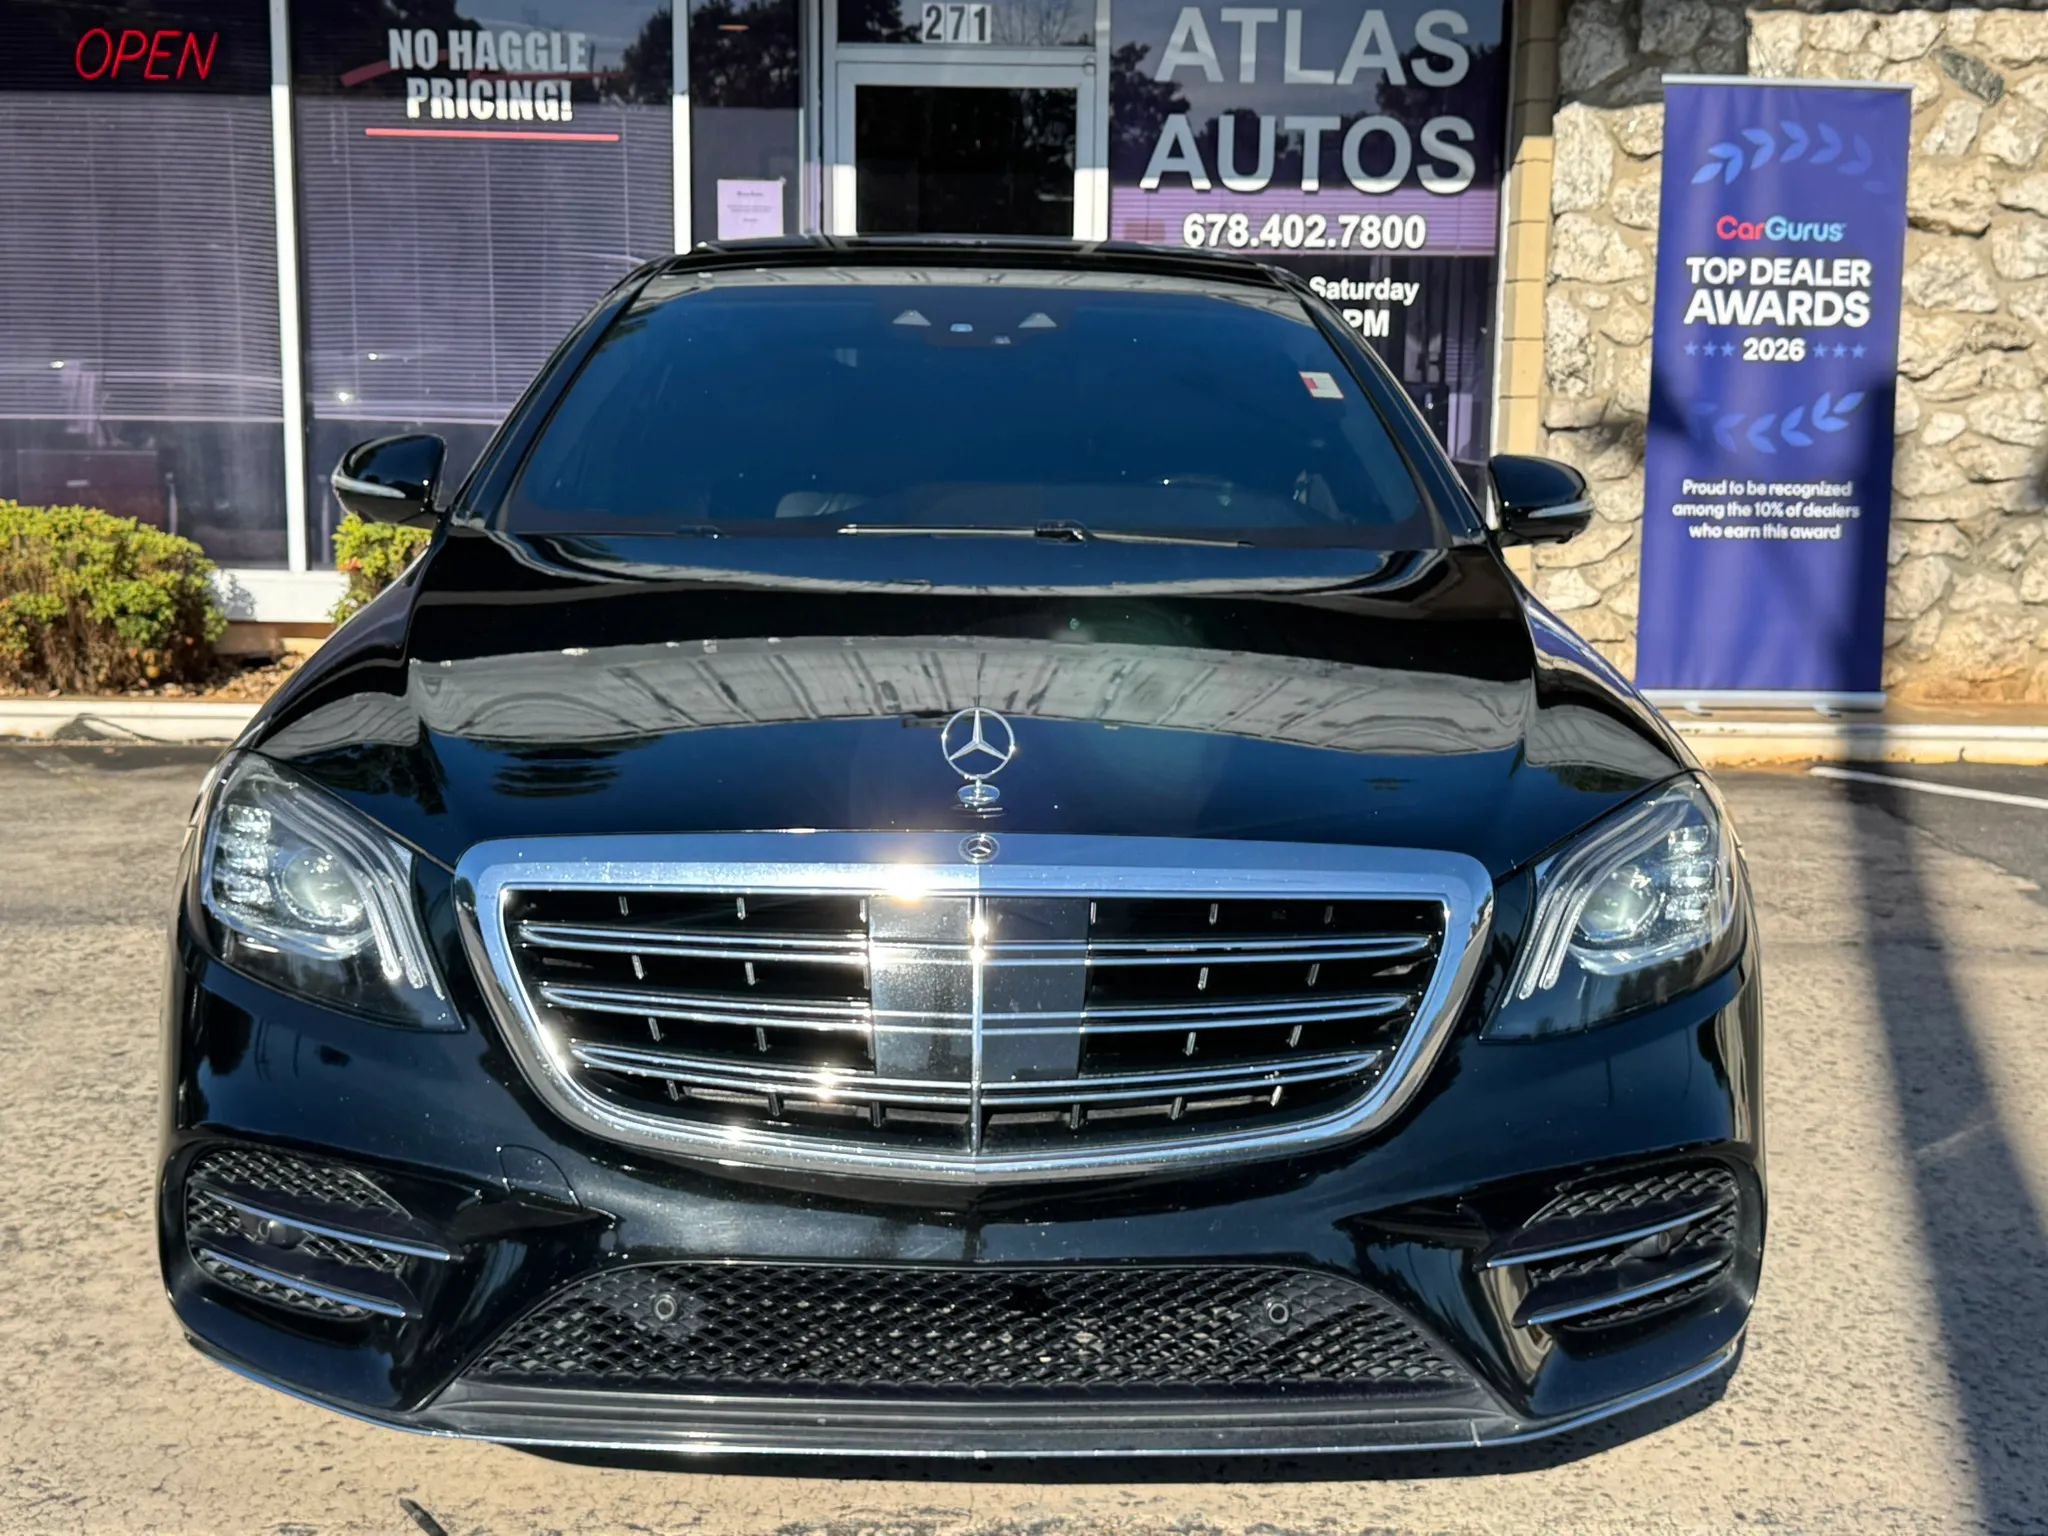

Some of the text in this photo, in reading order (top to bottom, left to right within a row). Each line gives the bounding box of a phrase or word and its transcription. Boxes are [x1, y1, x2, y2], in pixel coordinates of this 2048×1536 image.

[925, 5, 987, 41] 271
[75, 28, 218, 80] OPEN
[388, 28, 588, 73] NO HAGGLE
[1154, 7, 1470, 87] ATLAS
[406, 77, 573, 121] PRICING!
[1139, 114, 1476, 194] AUTOS
[1183, 213, 1426, 250] 678.402.7800
[1716, 215, 1845, 242] CarGurus
[1685, 257, 1872, 287] TOP DEALER
[1309, 276, 1420, 306] Saturday
[1683, 289, 1871, 328] AWARDS
[1742, 337, 1806, 361] 2026
[1682, 479, 1853, 499] Proud to be recognized
[1672, 502, 1860, 520] among the 10% of dealers
[1689, 523, 1842, 539] who earn this award
